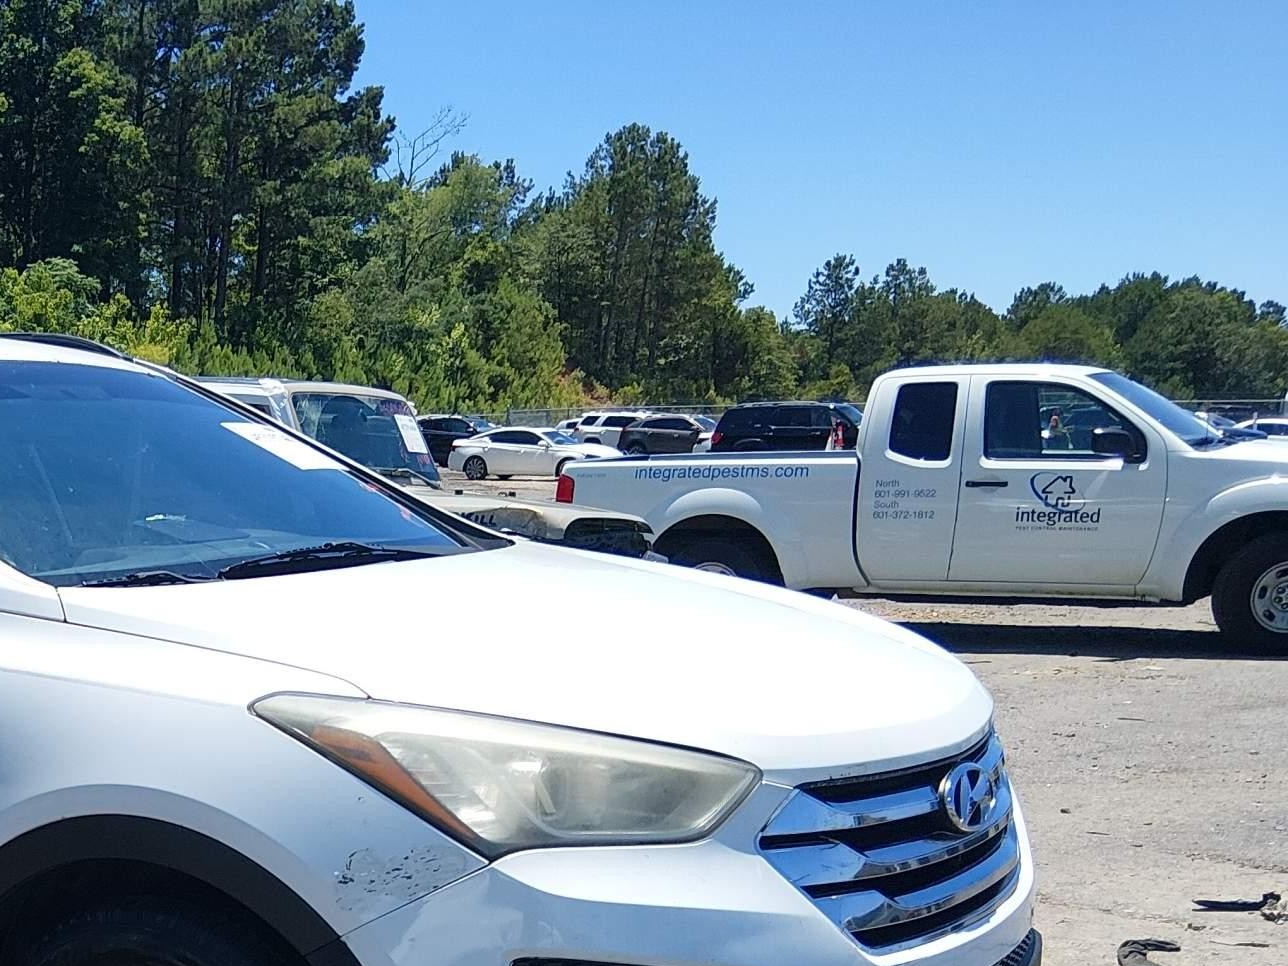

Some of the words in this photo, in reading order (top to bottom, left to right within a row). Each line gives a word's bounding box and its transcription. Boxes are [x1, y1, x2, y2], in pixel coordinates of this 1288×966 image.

[634, 465, 810, 482] integratedpestms.com
[875, 479, 900, 488] North
[874, 489, 937, 498] 601-991-9522
[873, 500, 899, 509] South
[872, 510, 935, 520] 601-372-1812
[1015, 506, 1101, 526] integrated
